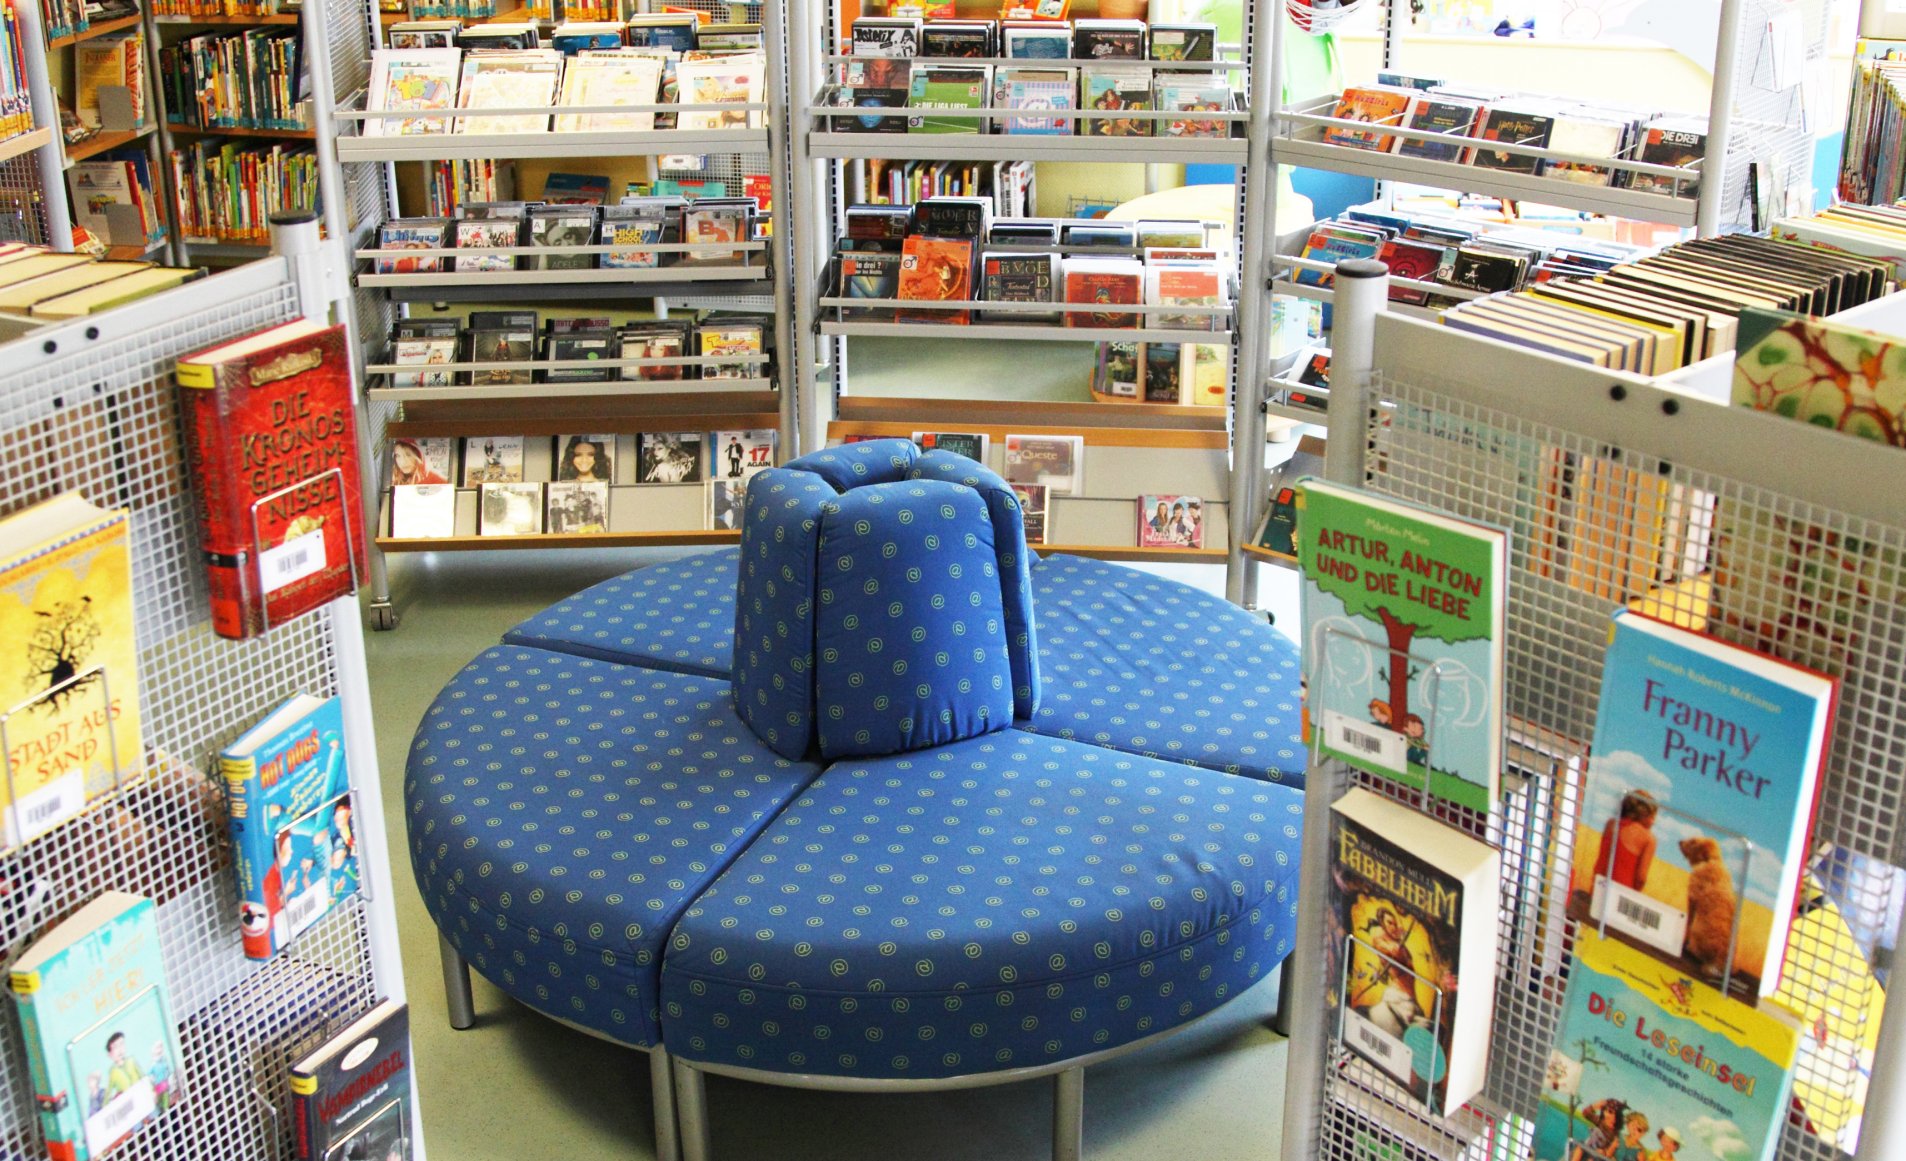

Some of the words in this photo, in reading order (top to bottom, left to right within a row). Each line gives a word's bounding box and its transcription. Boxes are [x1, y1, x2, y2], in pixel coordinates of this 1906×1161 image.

[854, 28, 896, 43] Asterix
[614, 228, 643, 239] HIGH
[272, 390, 310, 428] DIE
[240, 408, 344, 472] KRONOS
[251, 440, 345, 496] GEHEIM
[748, 447, 771, 462] 17
[1021, 450, 1058, 462] Queste
[269, 475, 336, 525] NISSE
[1317, 553, 1359, 584] UND
[1364, 570, 1400, 597] DIE
[1406, 580, 1471, 622] LIEBE
[1318, 527, 1395, 567] ARTUR,
[1400, 550, 1482, 598] ANTON
[8, 719, 74, 778] STADT
[79, 698, 122, 737] AUS
[1644, 678, 1760, 762] Franny
[37, 738, 98, 784] SAND
[1663, 727, 1772, 800] Parker
[1588, 991, 1627, 1029] Die
[1635, 1016, 1756, 1098] Leseinsel
[1656, 1056, 1690, 1081] starke
[1593, 1035, 1734, 1119] Freundschaftsgeschichten
